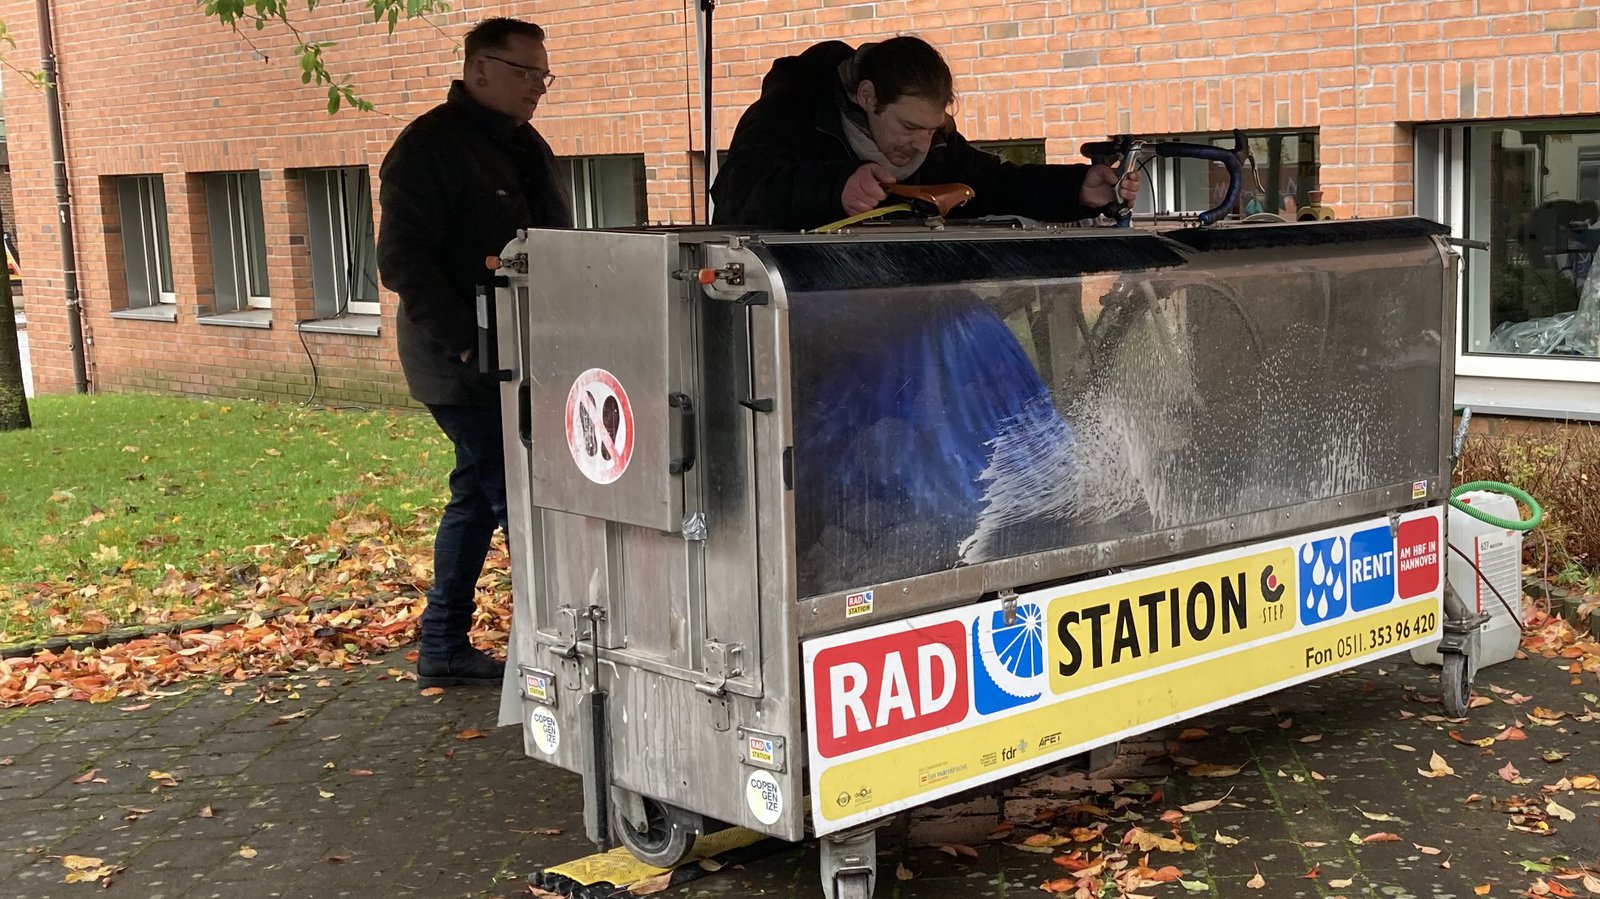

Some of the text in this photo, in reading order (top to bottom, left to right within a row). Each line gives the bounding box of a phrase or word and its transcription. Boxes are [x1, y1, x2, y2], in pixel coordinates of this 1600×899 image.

[1400, 540, 1436, 560] AM HBF IN
[1352, 551, 1393, 584] RENT
[1400, 553, 1437, 572] HANNOVER
[848, 595, 863, 606] RAD
[848, 605, 870, 615] STATION
[1263, 603, 1285, 624] STEP
[1305, 612, 1435, 668] Fon 0511. 353 96 420
[829, 572, 1248, 740] RAD STATION
[534, 713, 556, 726] COPEN
[543, 725, 556, 735] GEN
[546, 733, 557, 744] IZE
[750, 778, 778, 793] COPEN
[761, 790, 778, 803] GEN
[765, 801, 779, 812] IZE
